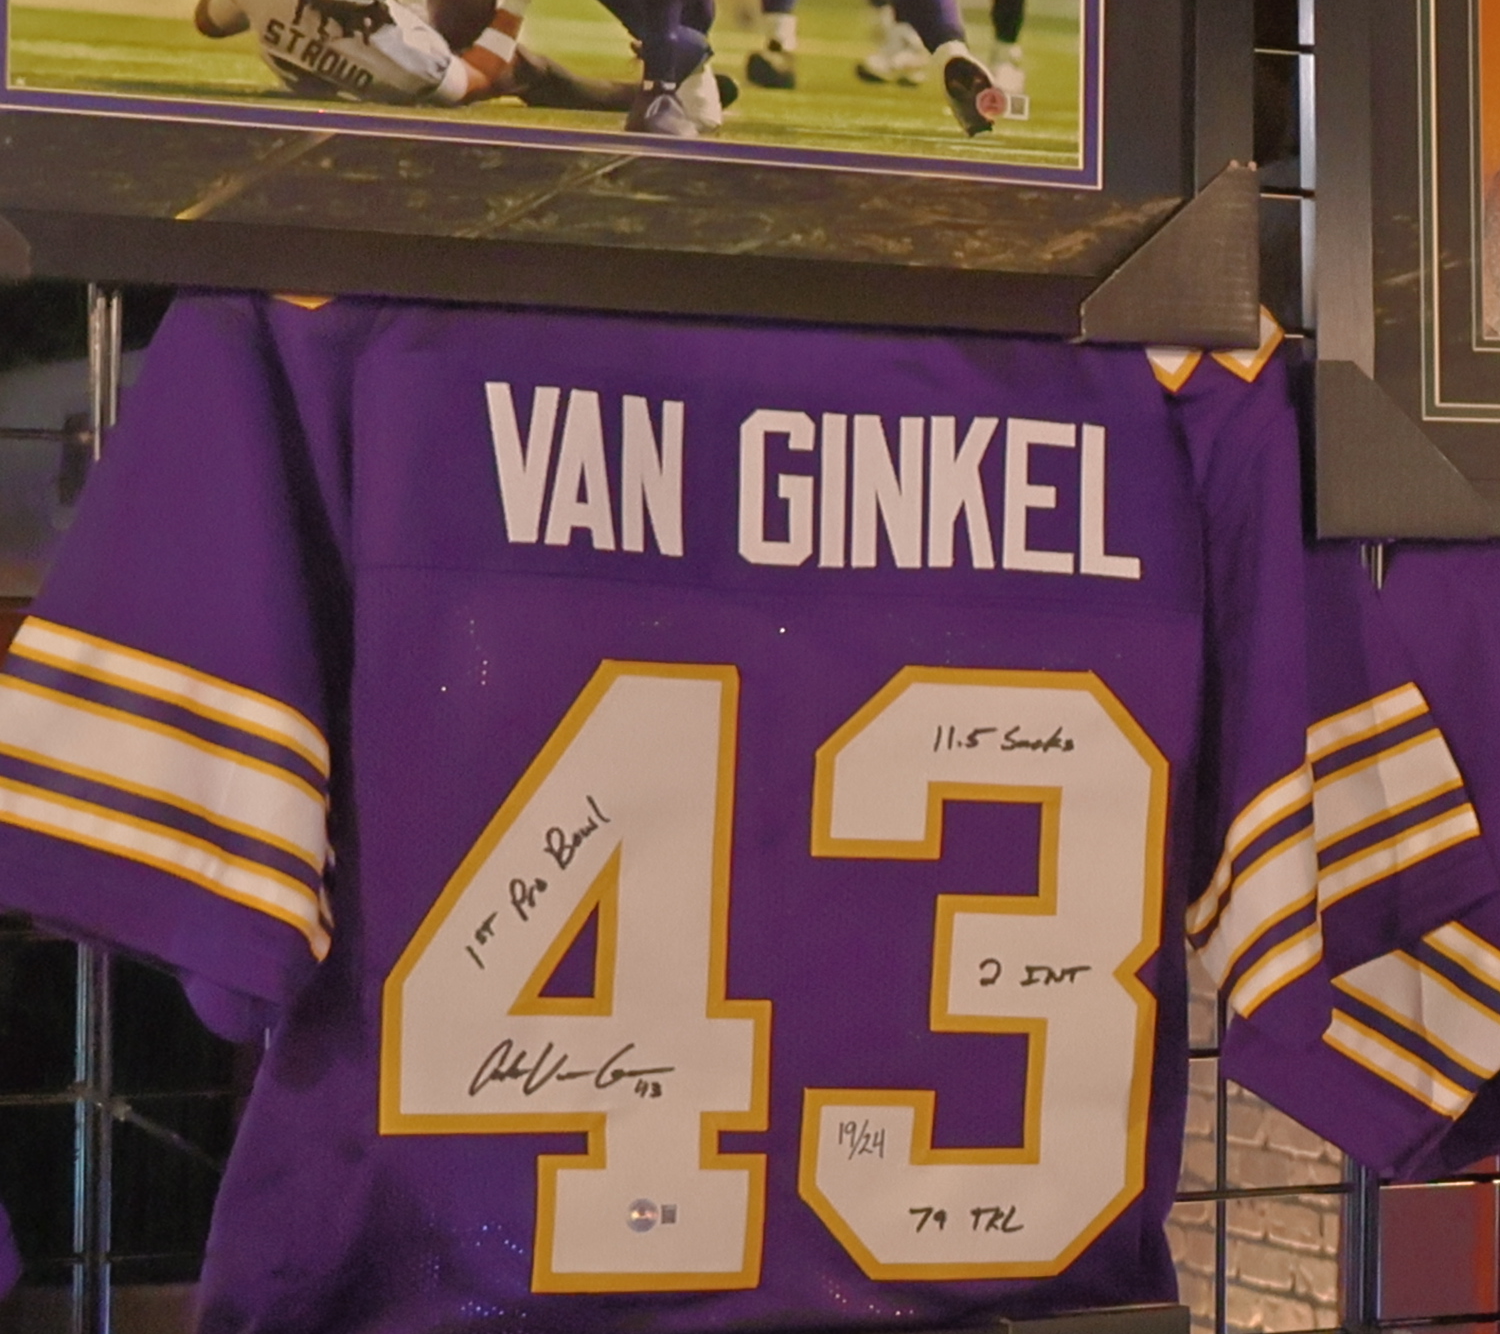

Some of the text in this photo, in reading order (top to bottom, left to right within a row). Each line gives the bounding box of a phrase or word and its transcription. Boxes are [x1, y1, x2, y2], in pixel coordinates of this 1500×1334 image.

[484, 381, 1141, 580] VAN GINKEL
[378, 657, 1170, 1293] 43
